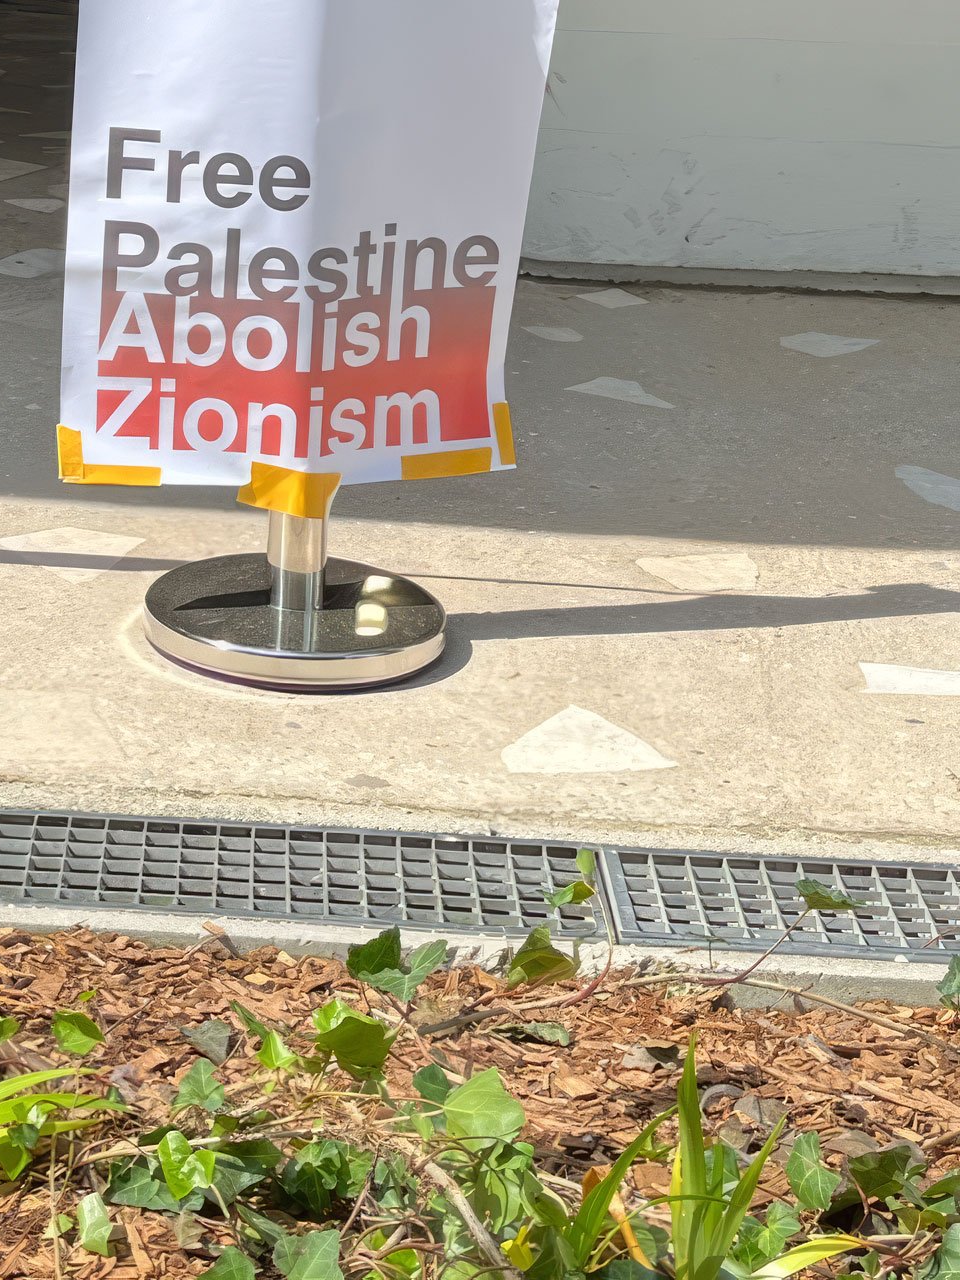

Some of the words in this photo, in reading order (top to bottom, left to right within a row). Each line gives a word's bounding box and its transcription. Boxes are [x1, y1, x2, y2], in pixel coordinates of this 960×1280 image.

[105, 126, 311, 212] Free
[101, 219, 500, 303] Palestine
[97, 288, 431, 373] Abolish
[96, 376, 442, 459] Zionism
